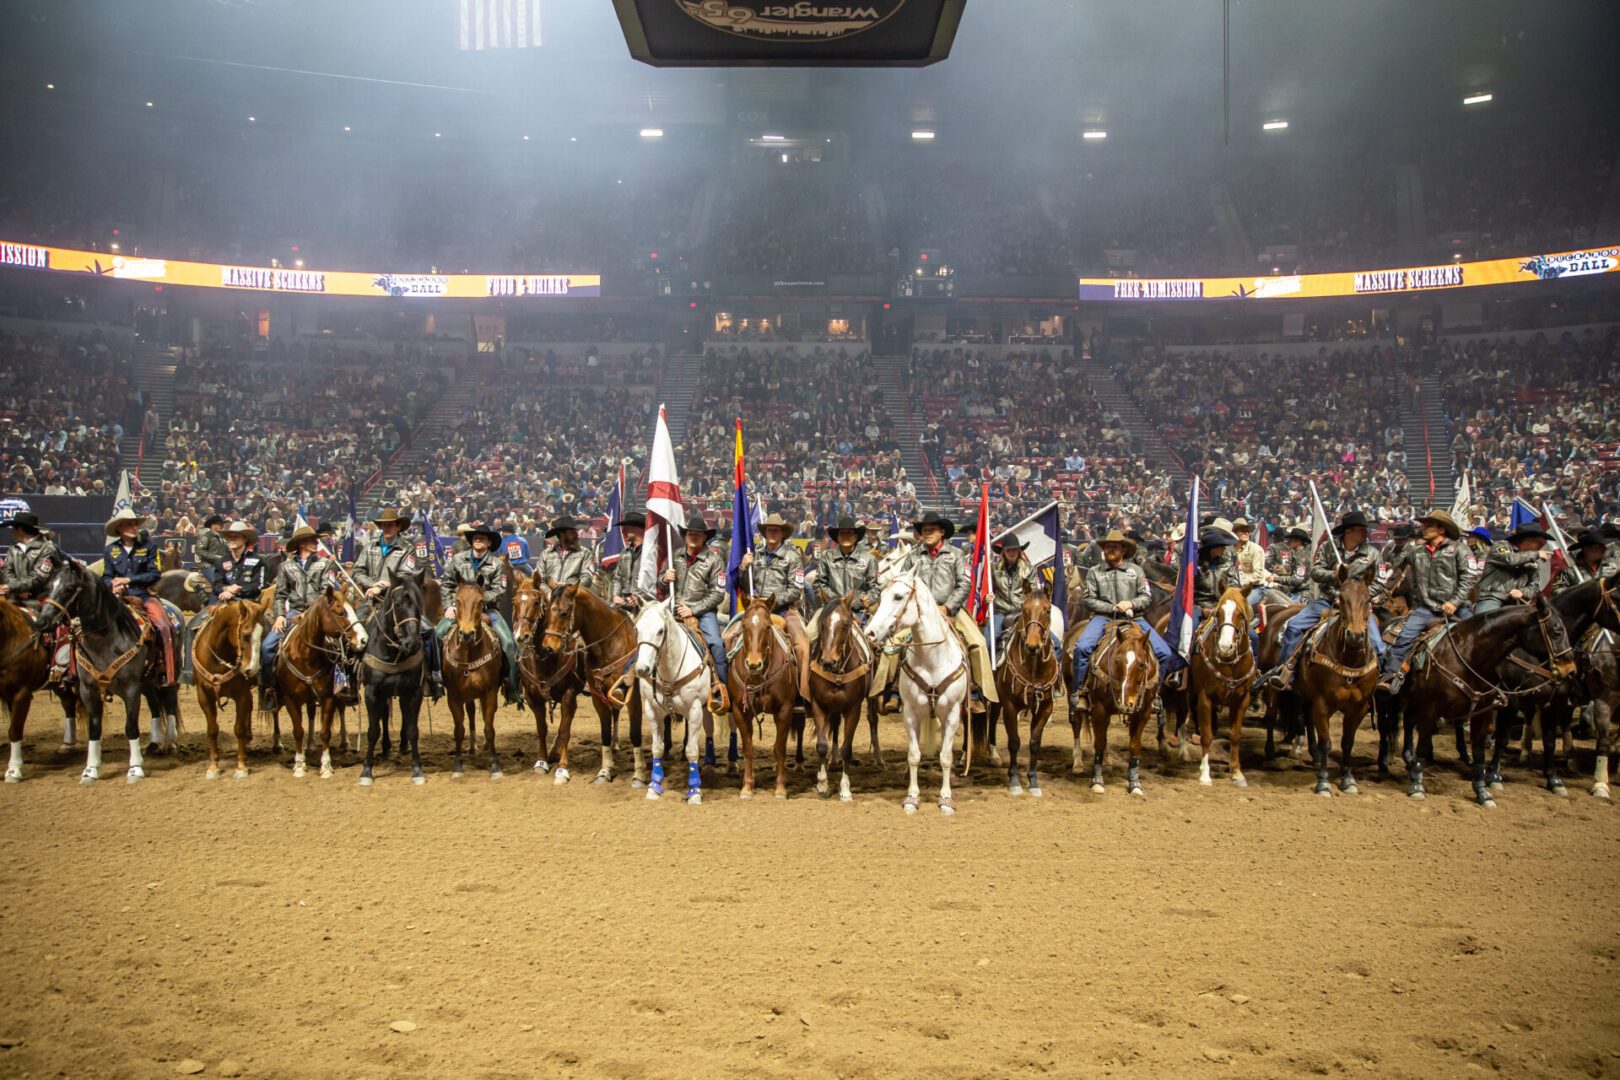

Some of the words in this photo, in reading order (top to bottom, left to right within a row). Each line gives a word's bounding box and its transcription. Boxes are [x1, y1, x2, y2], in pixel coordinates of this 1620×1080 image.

[759, 1, 880, 19] Wrangler
[1569, 259, 1609, 273] BALL
[1354, 270, 1406, 292] MASSIVE
[1409, 266, 1462, 287] SCREENS
[1114, 281, 1142, 298] FREE
[1143, 281, 1201, 298] ADMISSION
